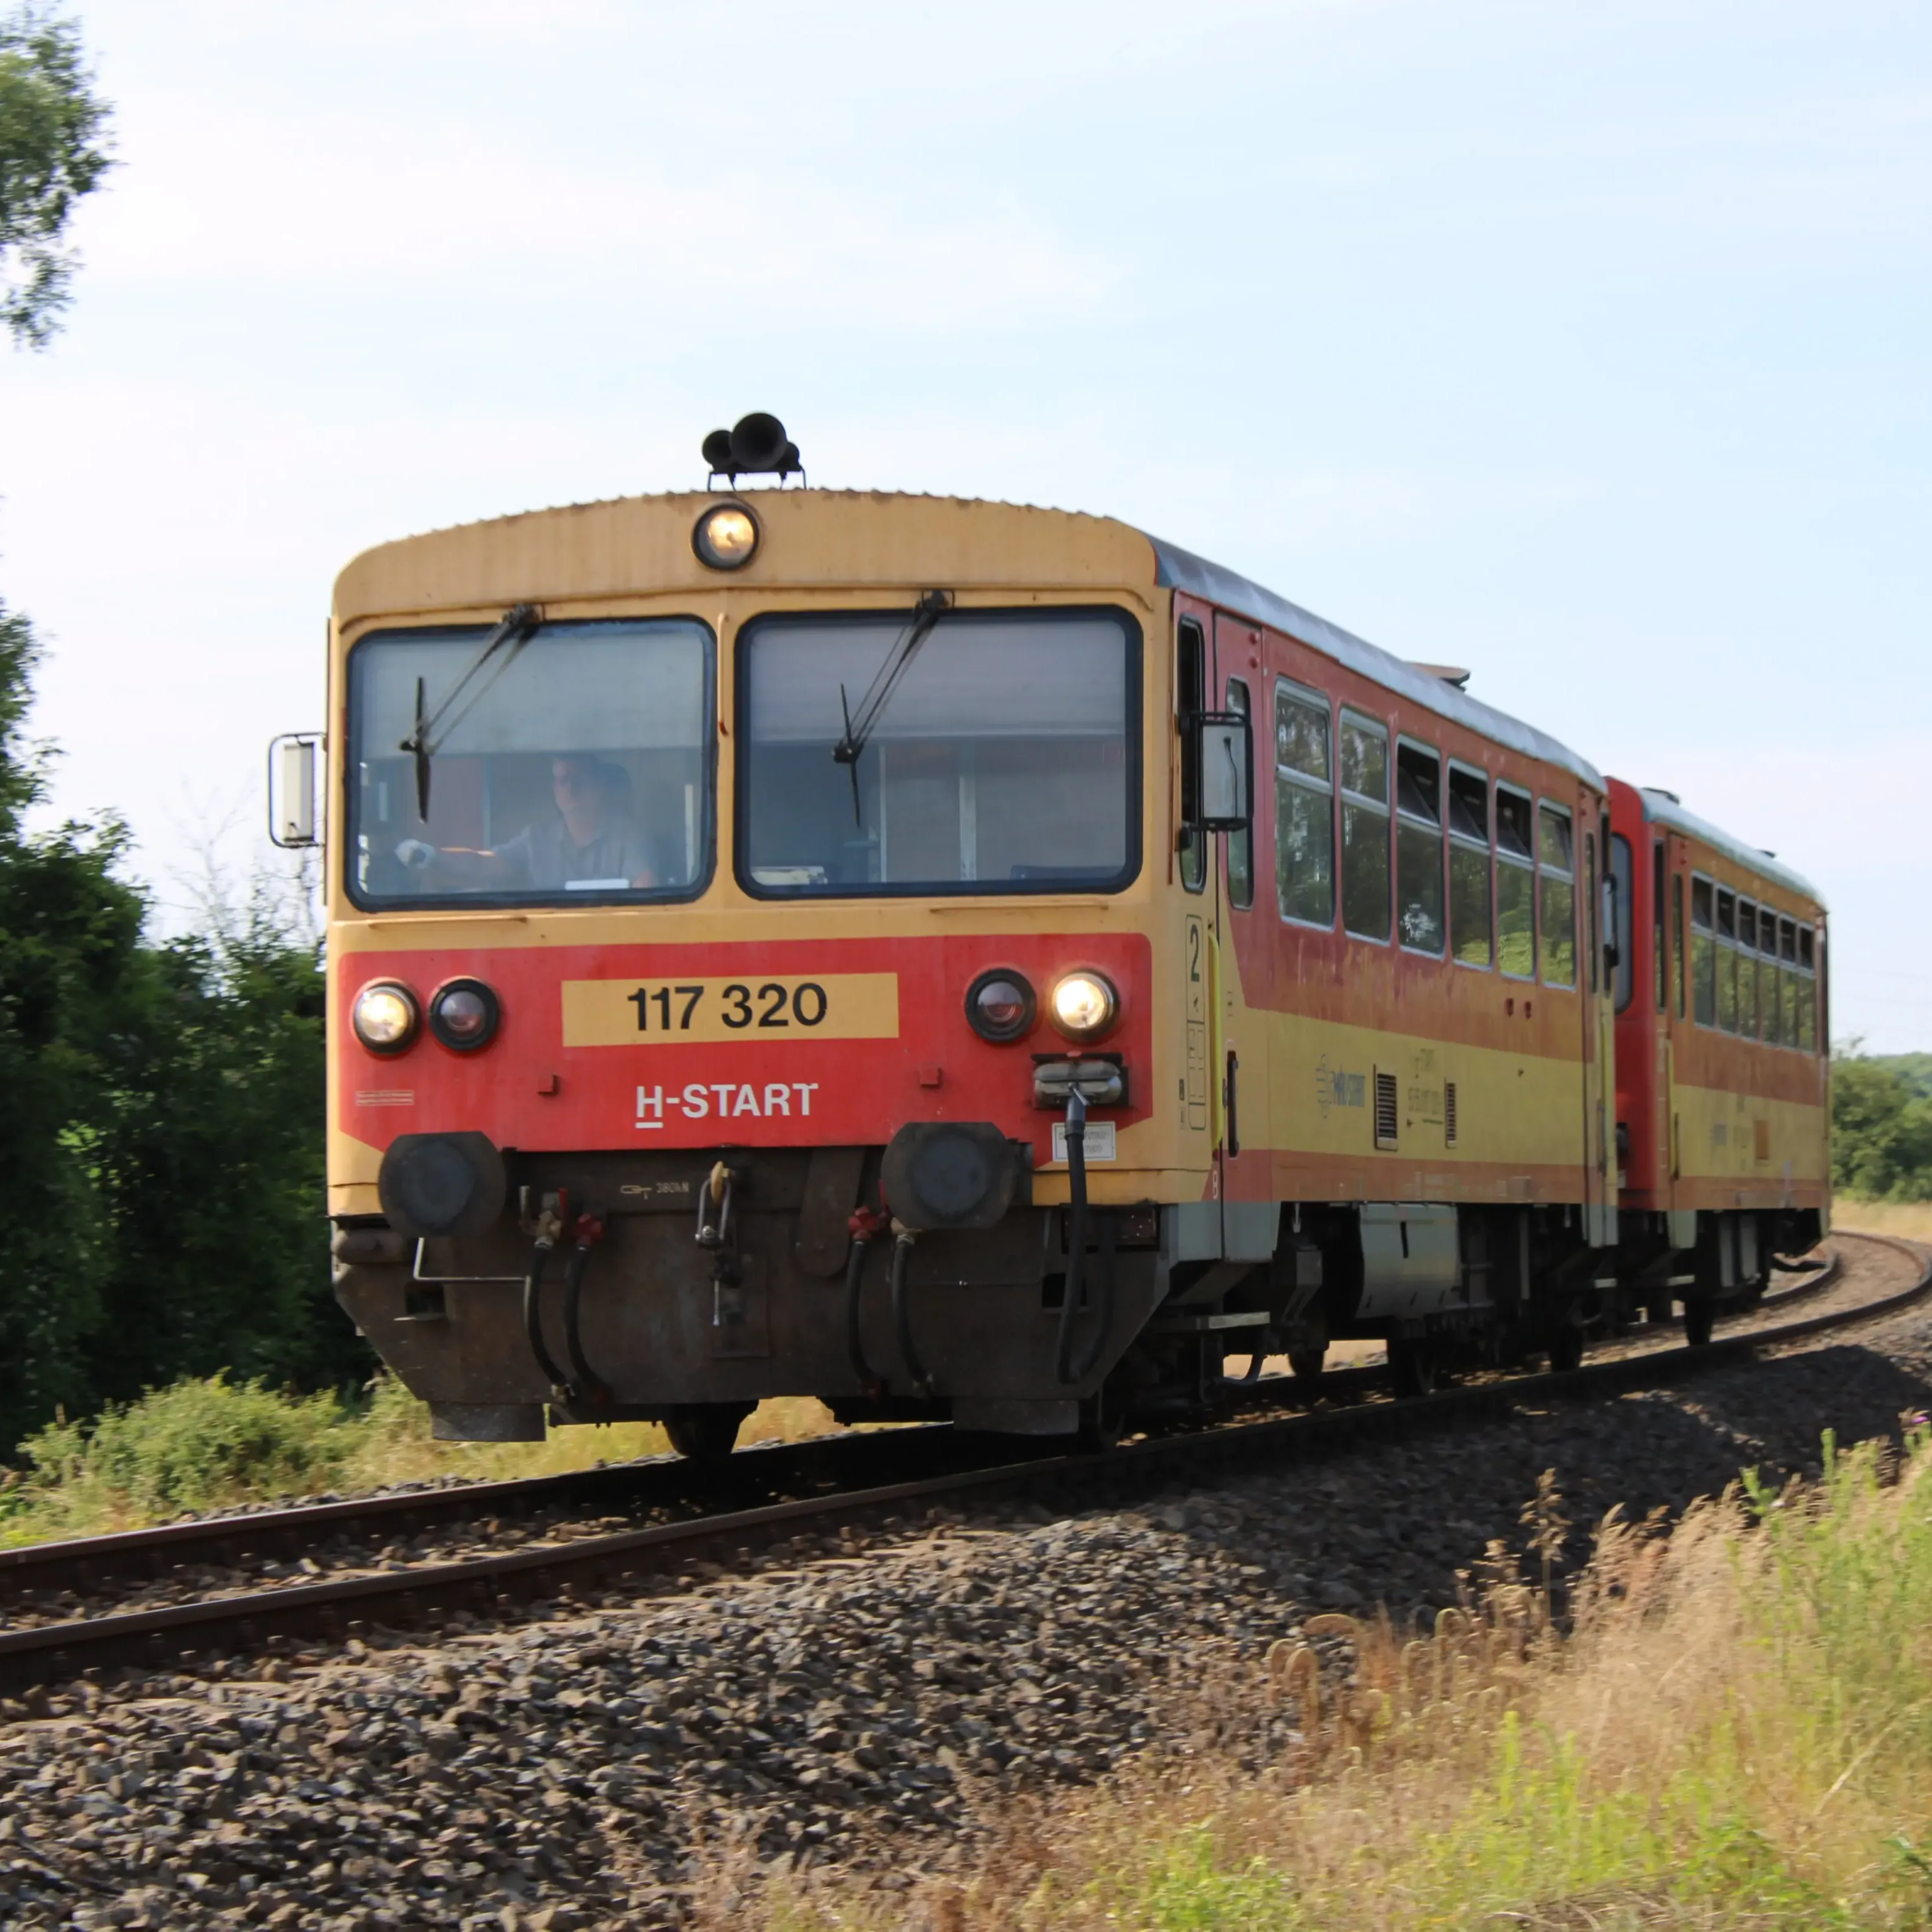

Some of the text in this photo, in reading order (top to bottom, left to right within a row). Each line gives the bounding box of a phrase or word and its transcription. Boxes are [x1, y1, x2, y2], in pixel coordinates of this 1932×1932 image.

[1190, 924, 1200, 982] 2
[627, 982, 828, 1031] 117 320
[636, 1083, 819, 1119] H-START
